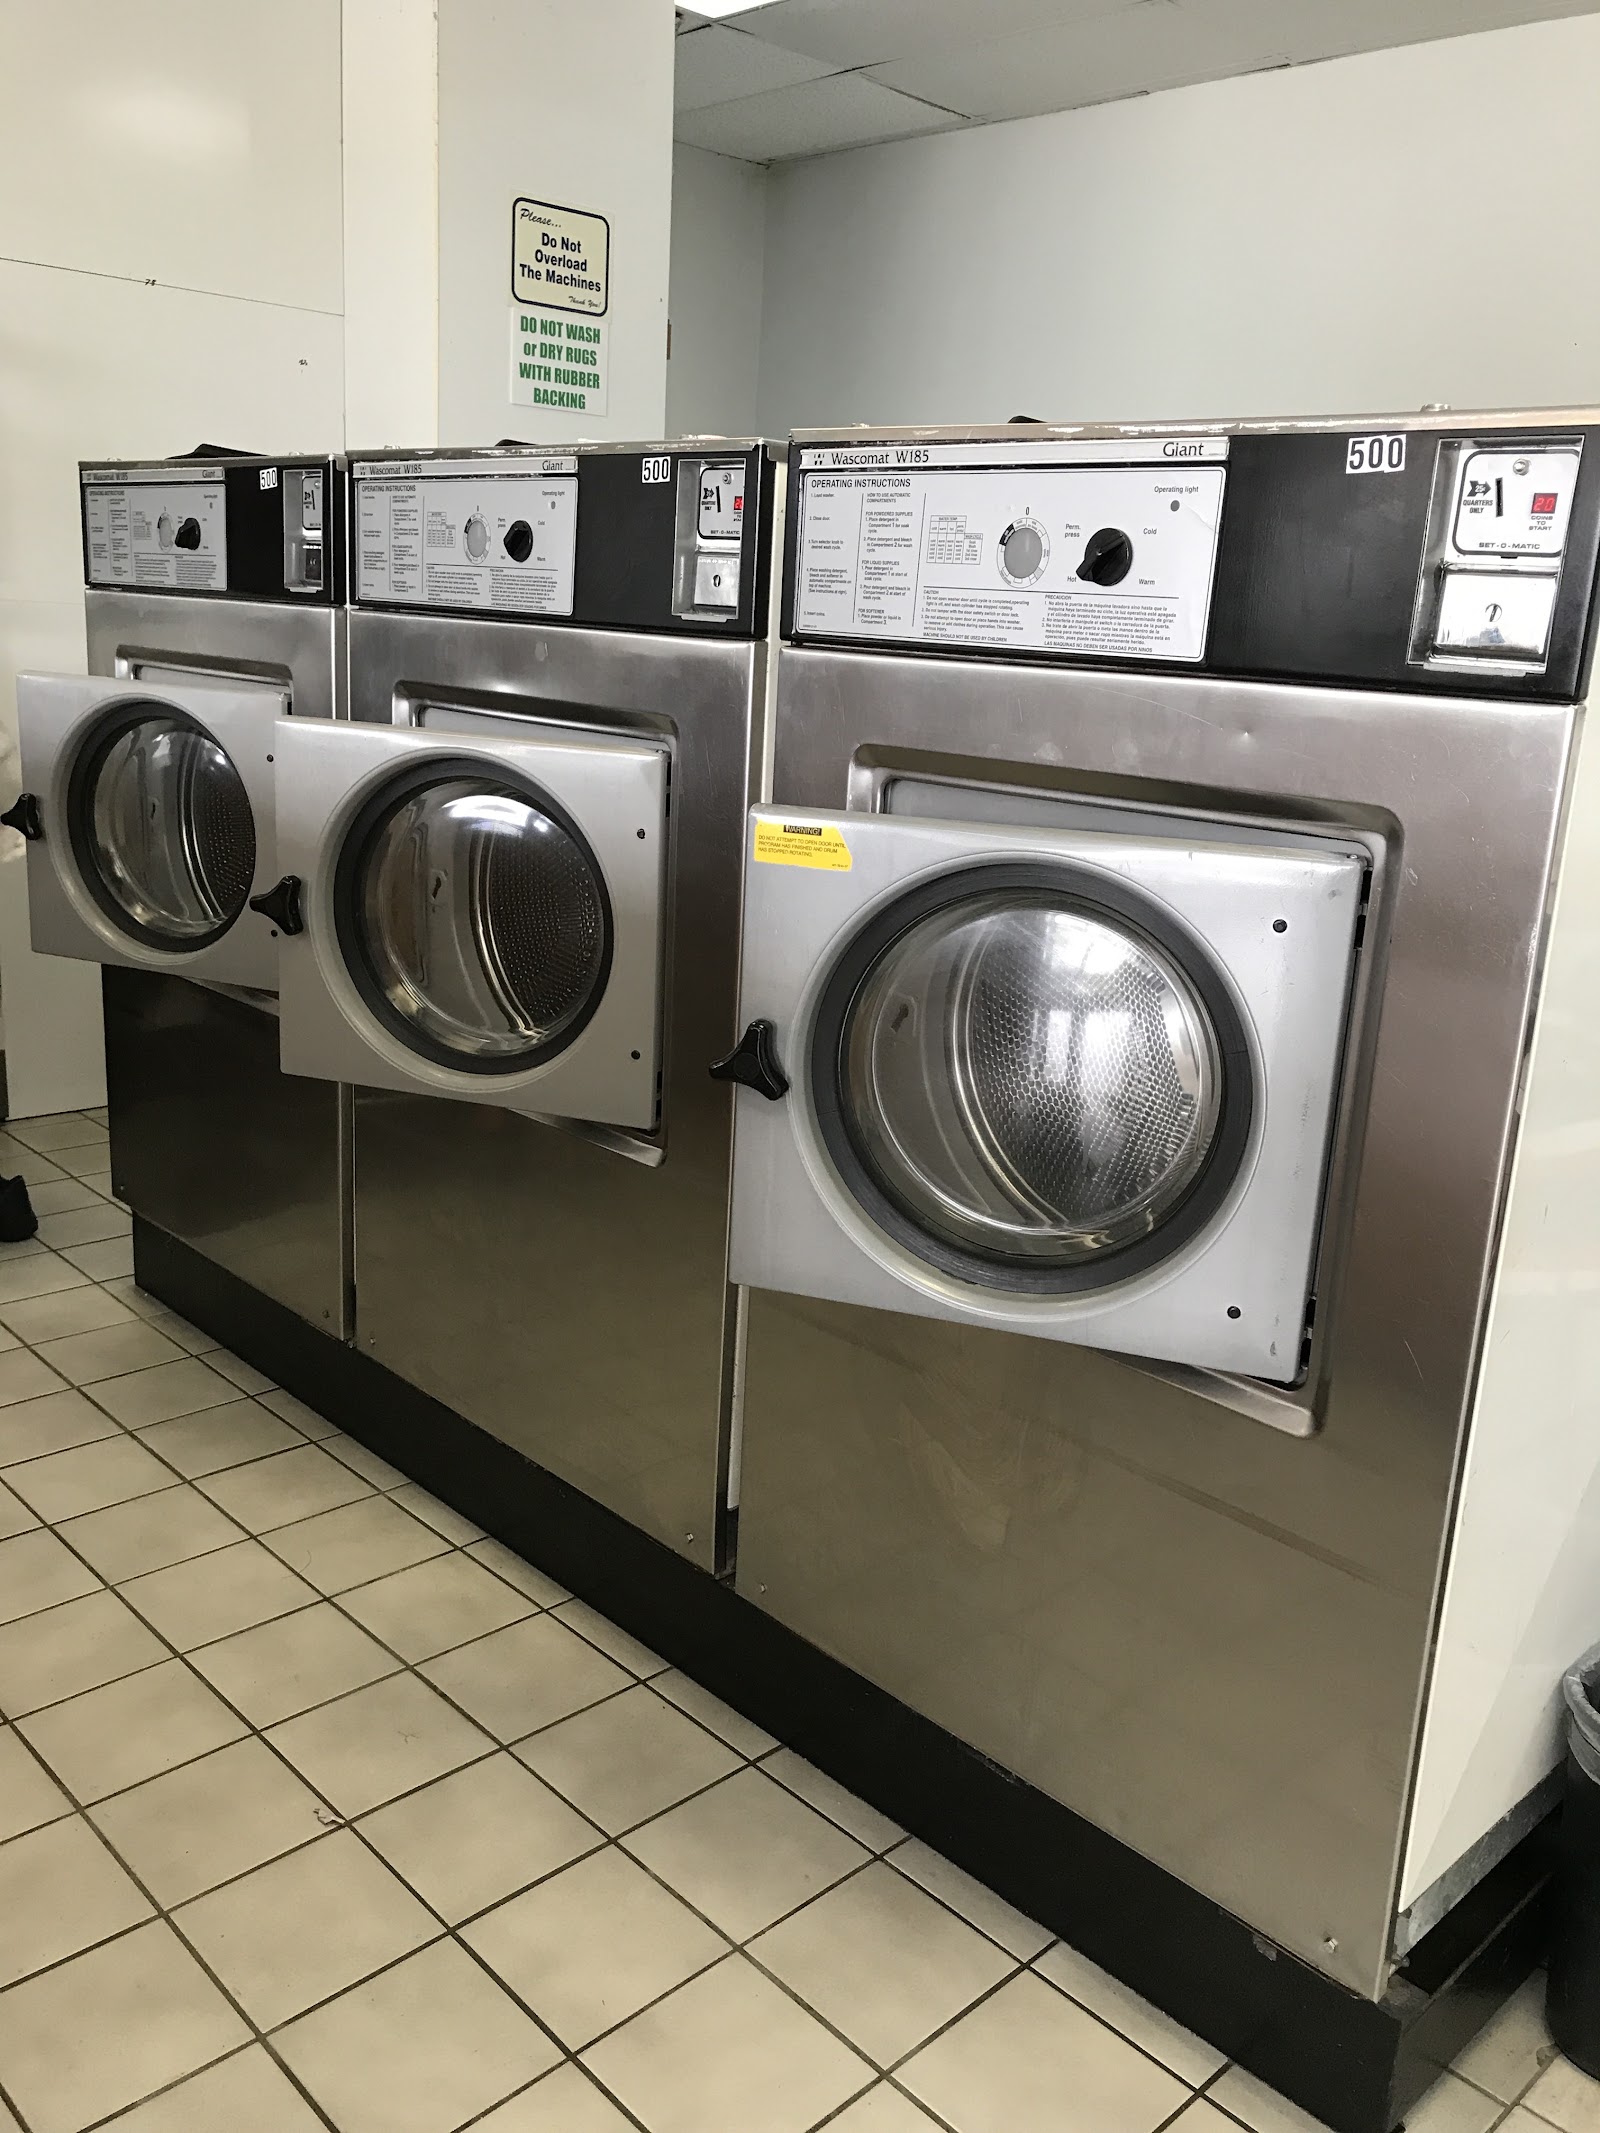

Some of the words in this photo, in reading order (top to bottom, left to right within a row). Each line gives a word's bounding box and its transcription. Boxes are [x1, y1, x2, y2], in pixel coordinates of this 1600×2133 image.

[520, 208, 562, 228] Please...
[542, 232, 557, 248] Do
[561, 237, 581, 253] Not
[535, 249, 587, 272] Overload
[520, 263, 541, 280] The
[546, 269, 601, 292] Machines
[568, 295, 586, 306] Thank
[520, 315, 537, 333] DO
[540, 319, 563, 338] NOT
[566, 323, 600, 344] WASH
[524, 342, 537, 357] or
[540, 342, 563, 360] DRY
[566, 346, 597, 366] RUGS
[519, 362, 551, 382] WITH
[555, 367, 600, 389] RUBBER
[534, 387, 586, 410] BACKING
[831, 453, 889, 465] Wascomat
[896, 449, 929, 464] W185
[1163, 442, 1204, 457] Giant
[1349, 438, 1403, 470] 500
[370, 465, 401, 475] Wascomat
[542, 460, 563, 471] Giant
[643, 459, 669, 481] 500
[261, 469, 277, 488] 500
[811, 479, 853, 488] OPERATING
[854, 478, 911, 488] INSTRUCTIONS
[1154, 486, 1183, 494] Operating
[1185, 486, 1199, 494] light
[1533, 497, 1555, 512] 20
[785, 825, 820, 836] WARNING!
